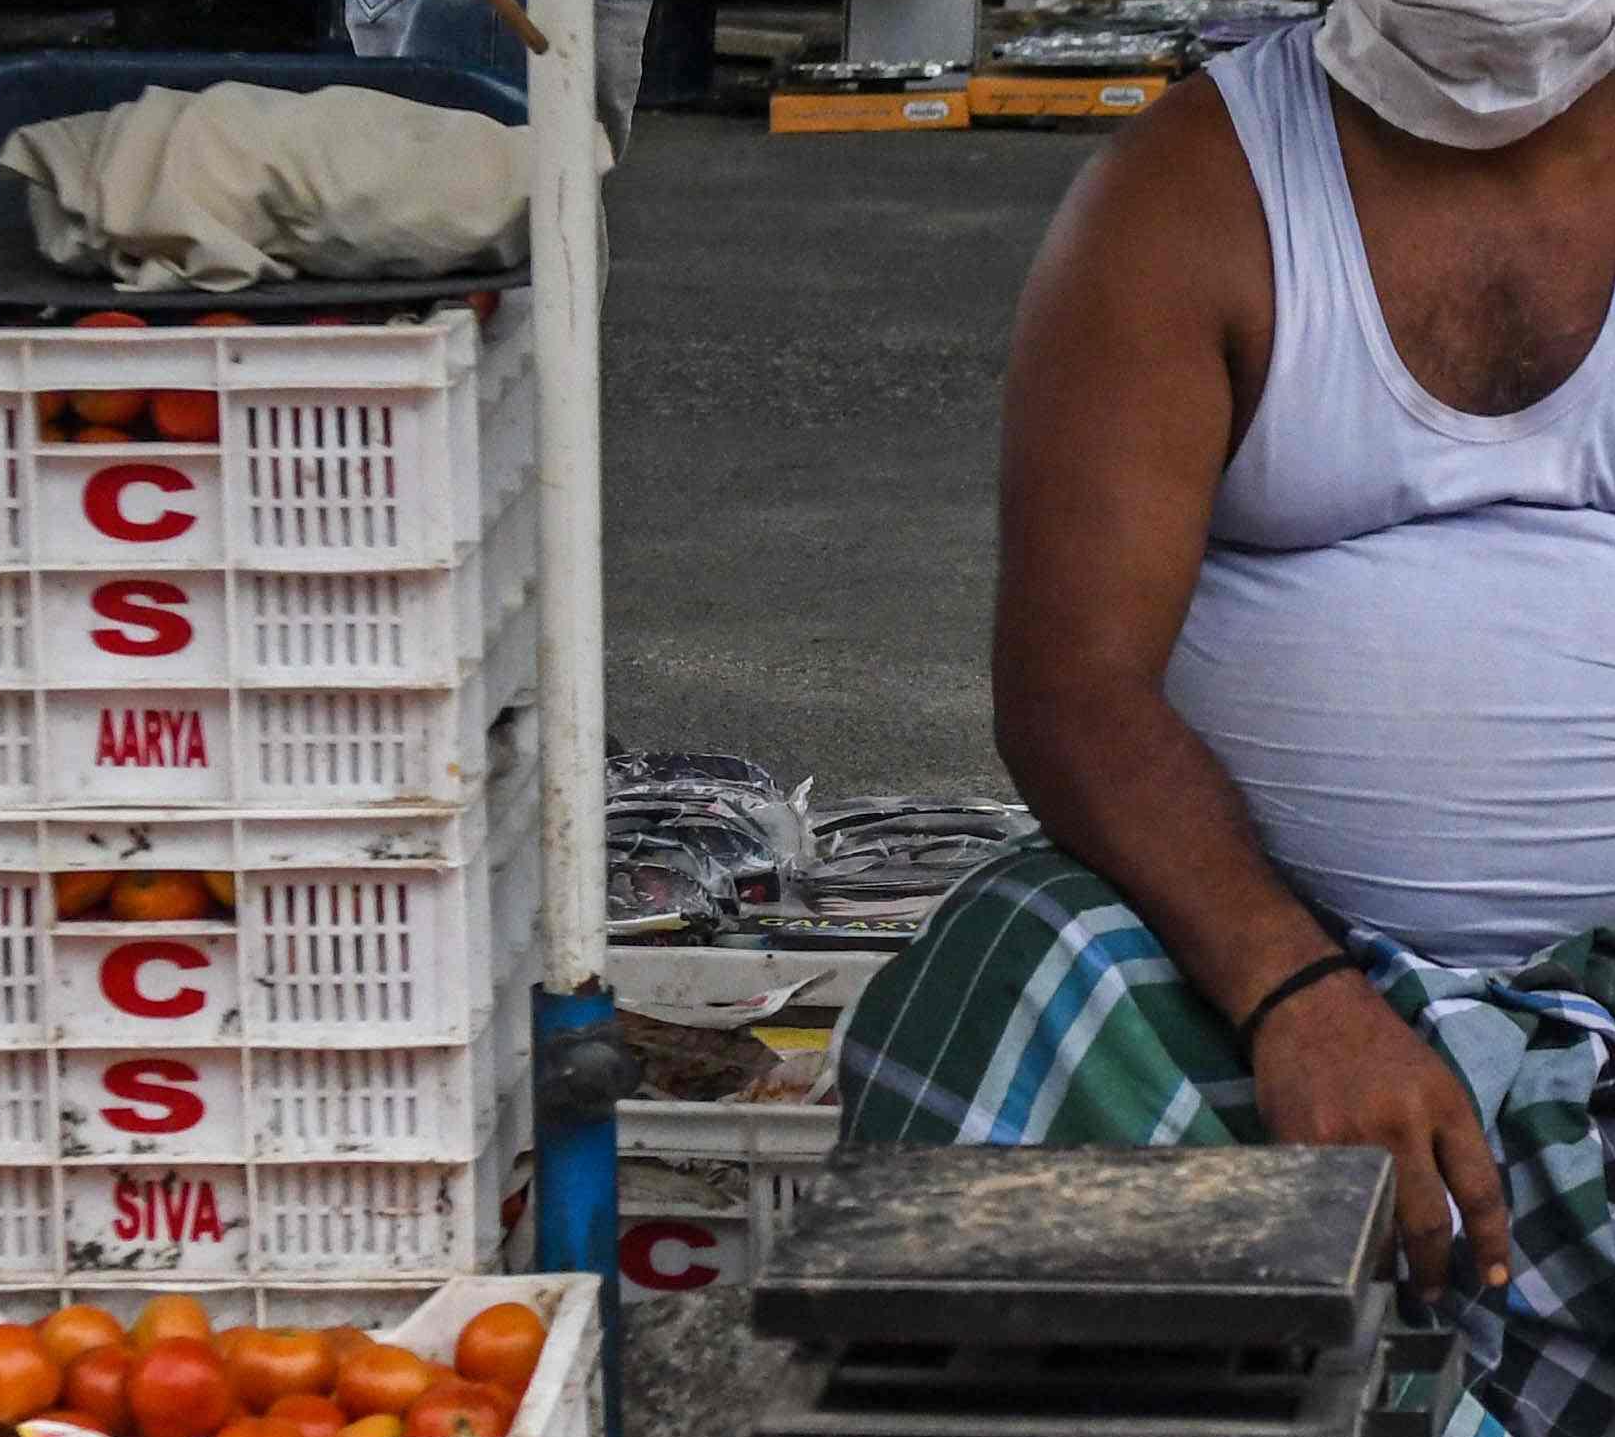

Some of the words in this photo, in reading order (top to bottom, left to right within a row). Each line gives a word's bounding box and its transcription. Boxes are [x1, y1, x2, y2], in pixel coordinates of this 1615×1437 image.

[82, 462, 198, 543] C
[91, 579, 193, 657] S
[96, 709, 209, 769] AARYA
[98, 940, 212, 1020] C
[99, 1058, 207, 1136] S
[113, 1178, 225, 1244] SIVA
